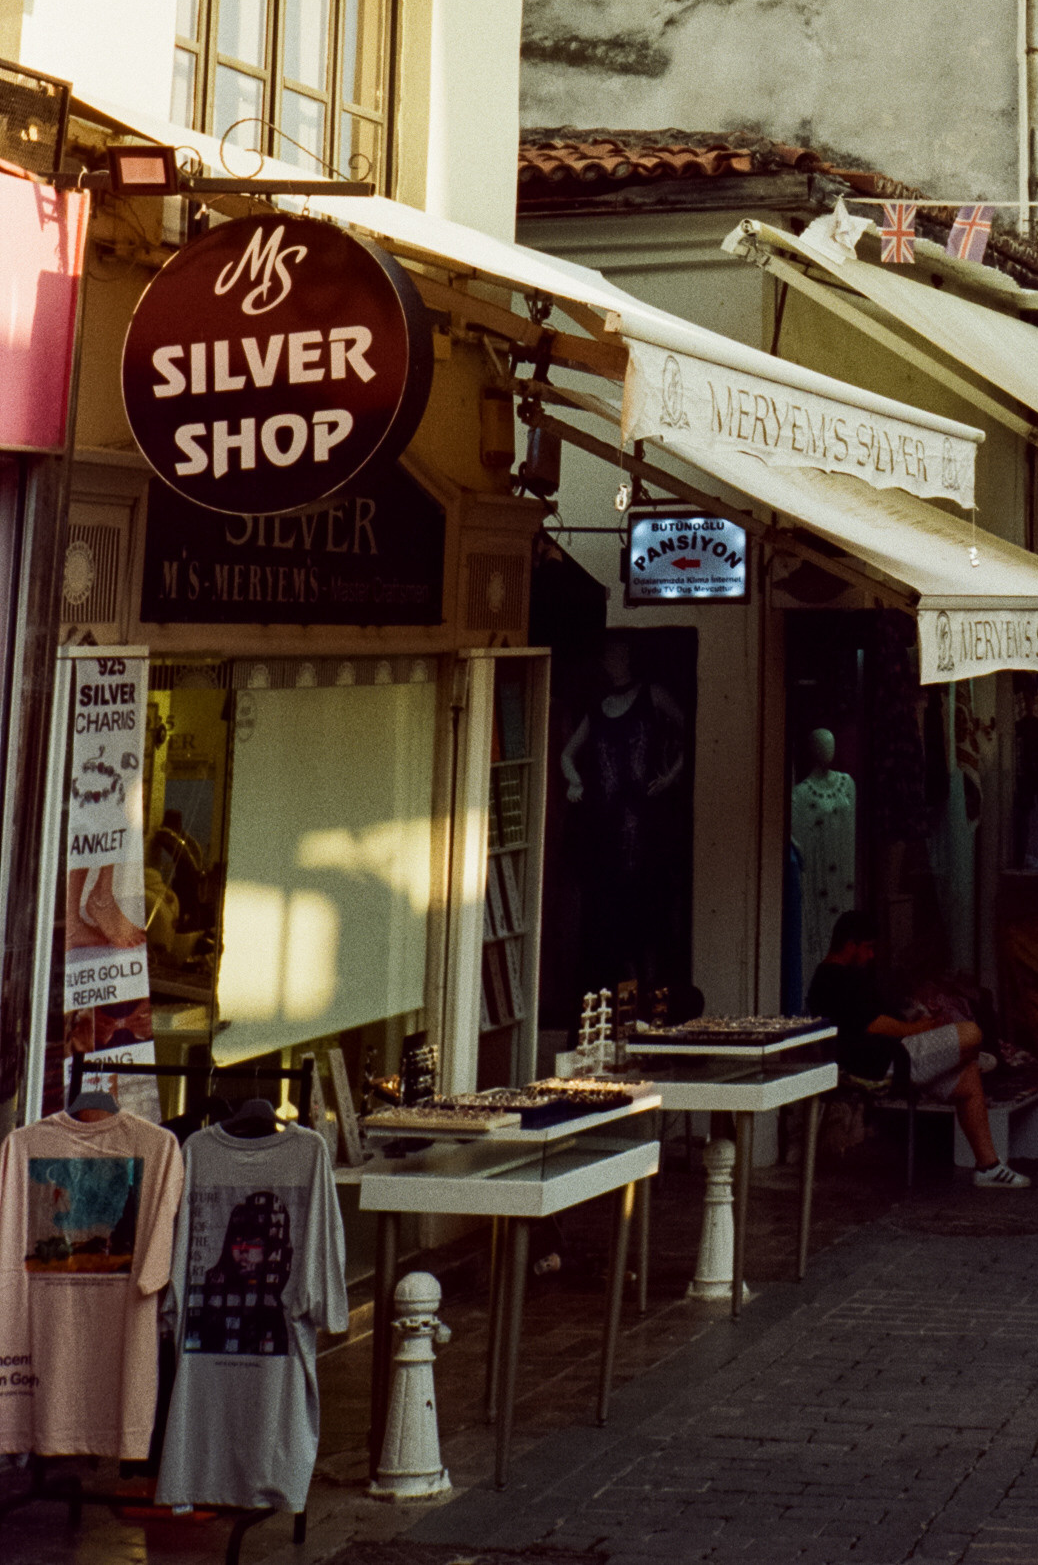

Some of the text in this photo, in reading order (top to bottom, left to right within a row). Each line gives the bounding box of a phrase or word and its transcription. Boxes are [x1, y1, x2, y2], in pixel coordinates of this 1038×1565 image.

[214, 224, 308, 315] MS
[152, 325, 377, 399] SILVER
[174, 408, 354, 479] SHOP
[856, 422, 928, 483] SILVER
[633, 531, 743, 572] PANSİYON
[97, 658, 126, 676] 925
[79, 682, 136, 707] SILVER
[70, 828, 127, 856] ANKLET
[98, 961, 143, 981] GOLD
[73, 985, 118, 1006] REPAIR
